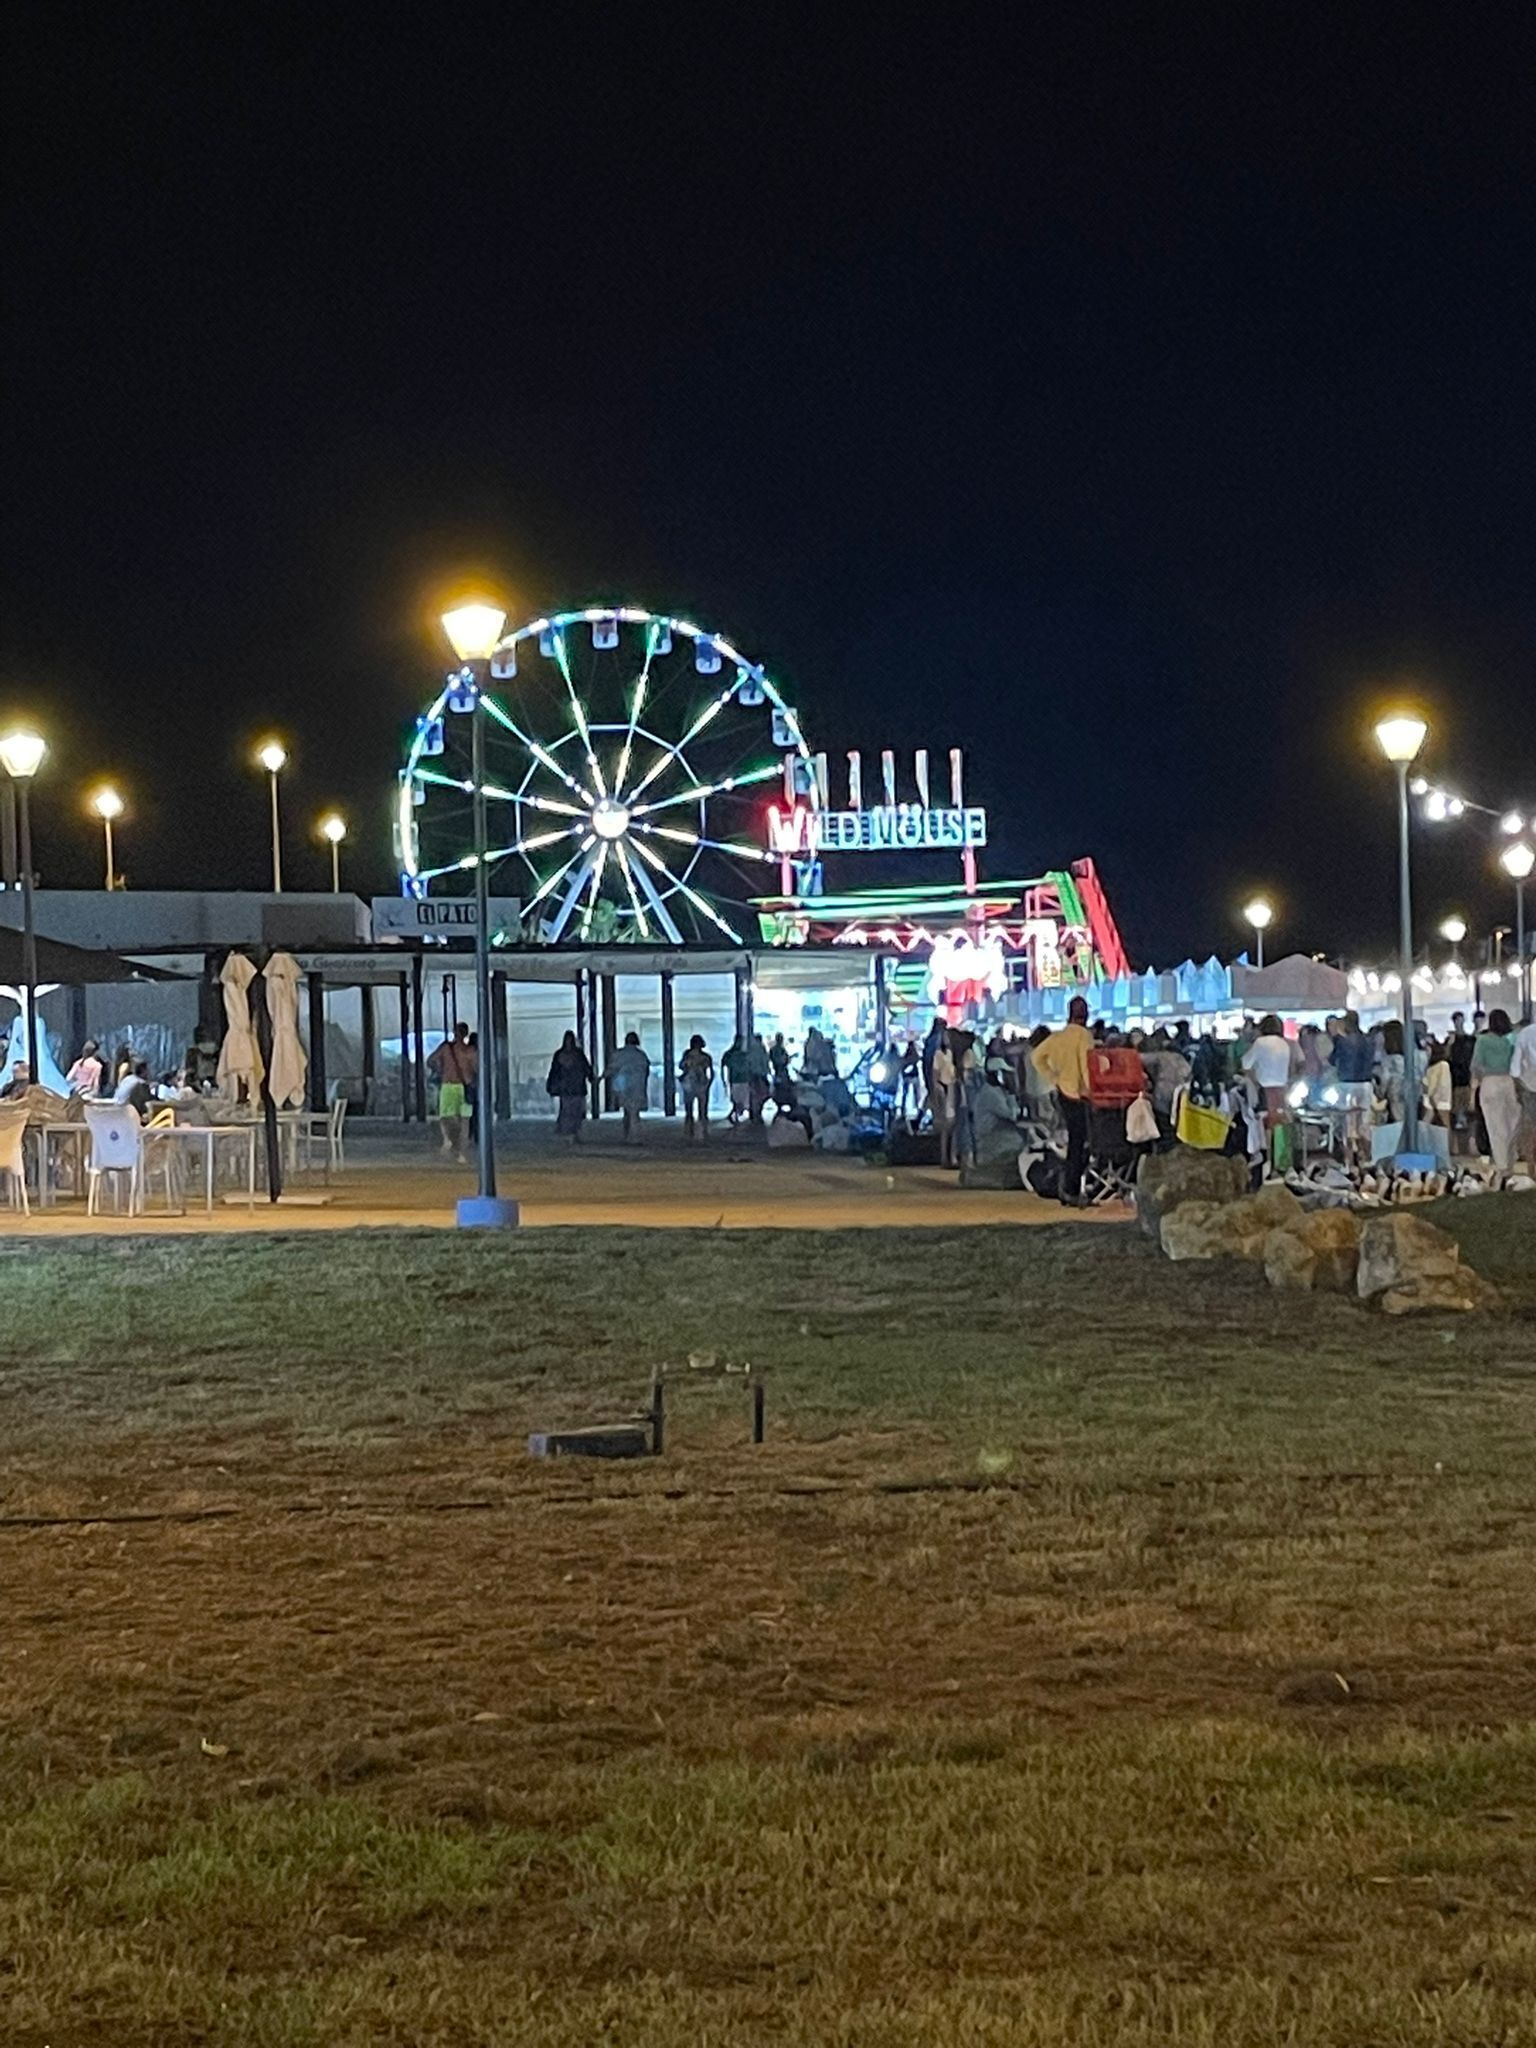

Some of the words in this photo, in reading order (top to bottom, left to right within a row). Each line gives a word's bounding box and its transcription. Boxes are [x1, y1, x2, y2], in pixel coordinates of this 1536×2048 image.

[768, 805, 861, 851] WILD
[871, 803, 986, 848] MOUSE
[438, 904, 477, 922] PATO
